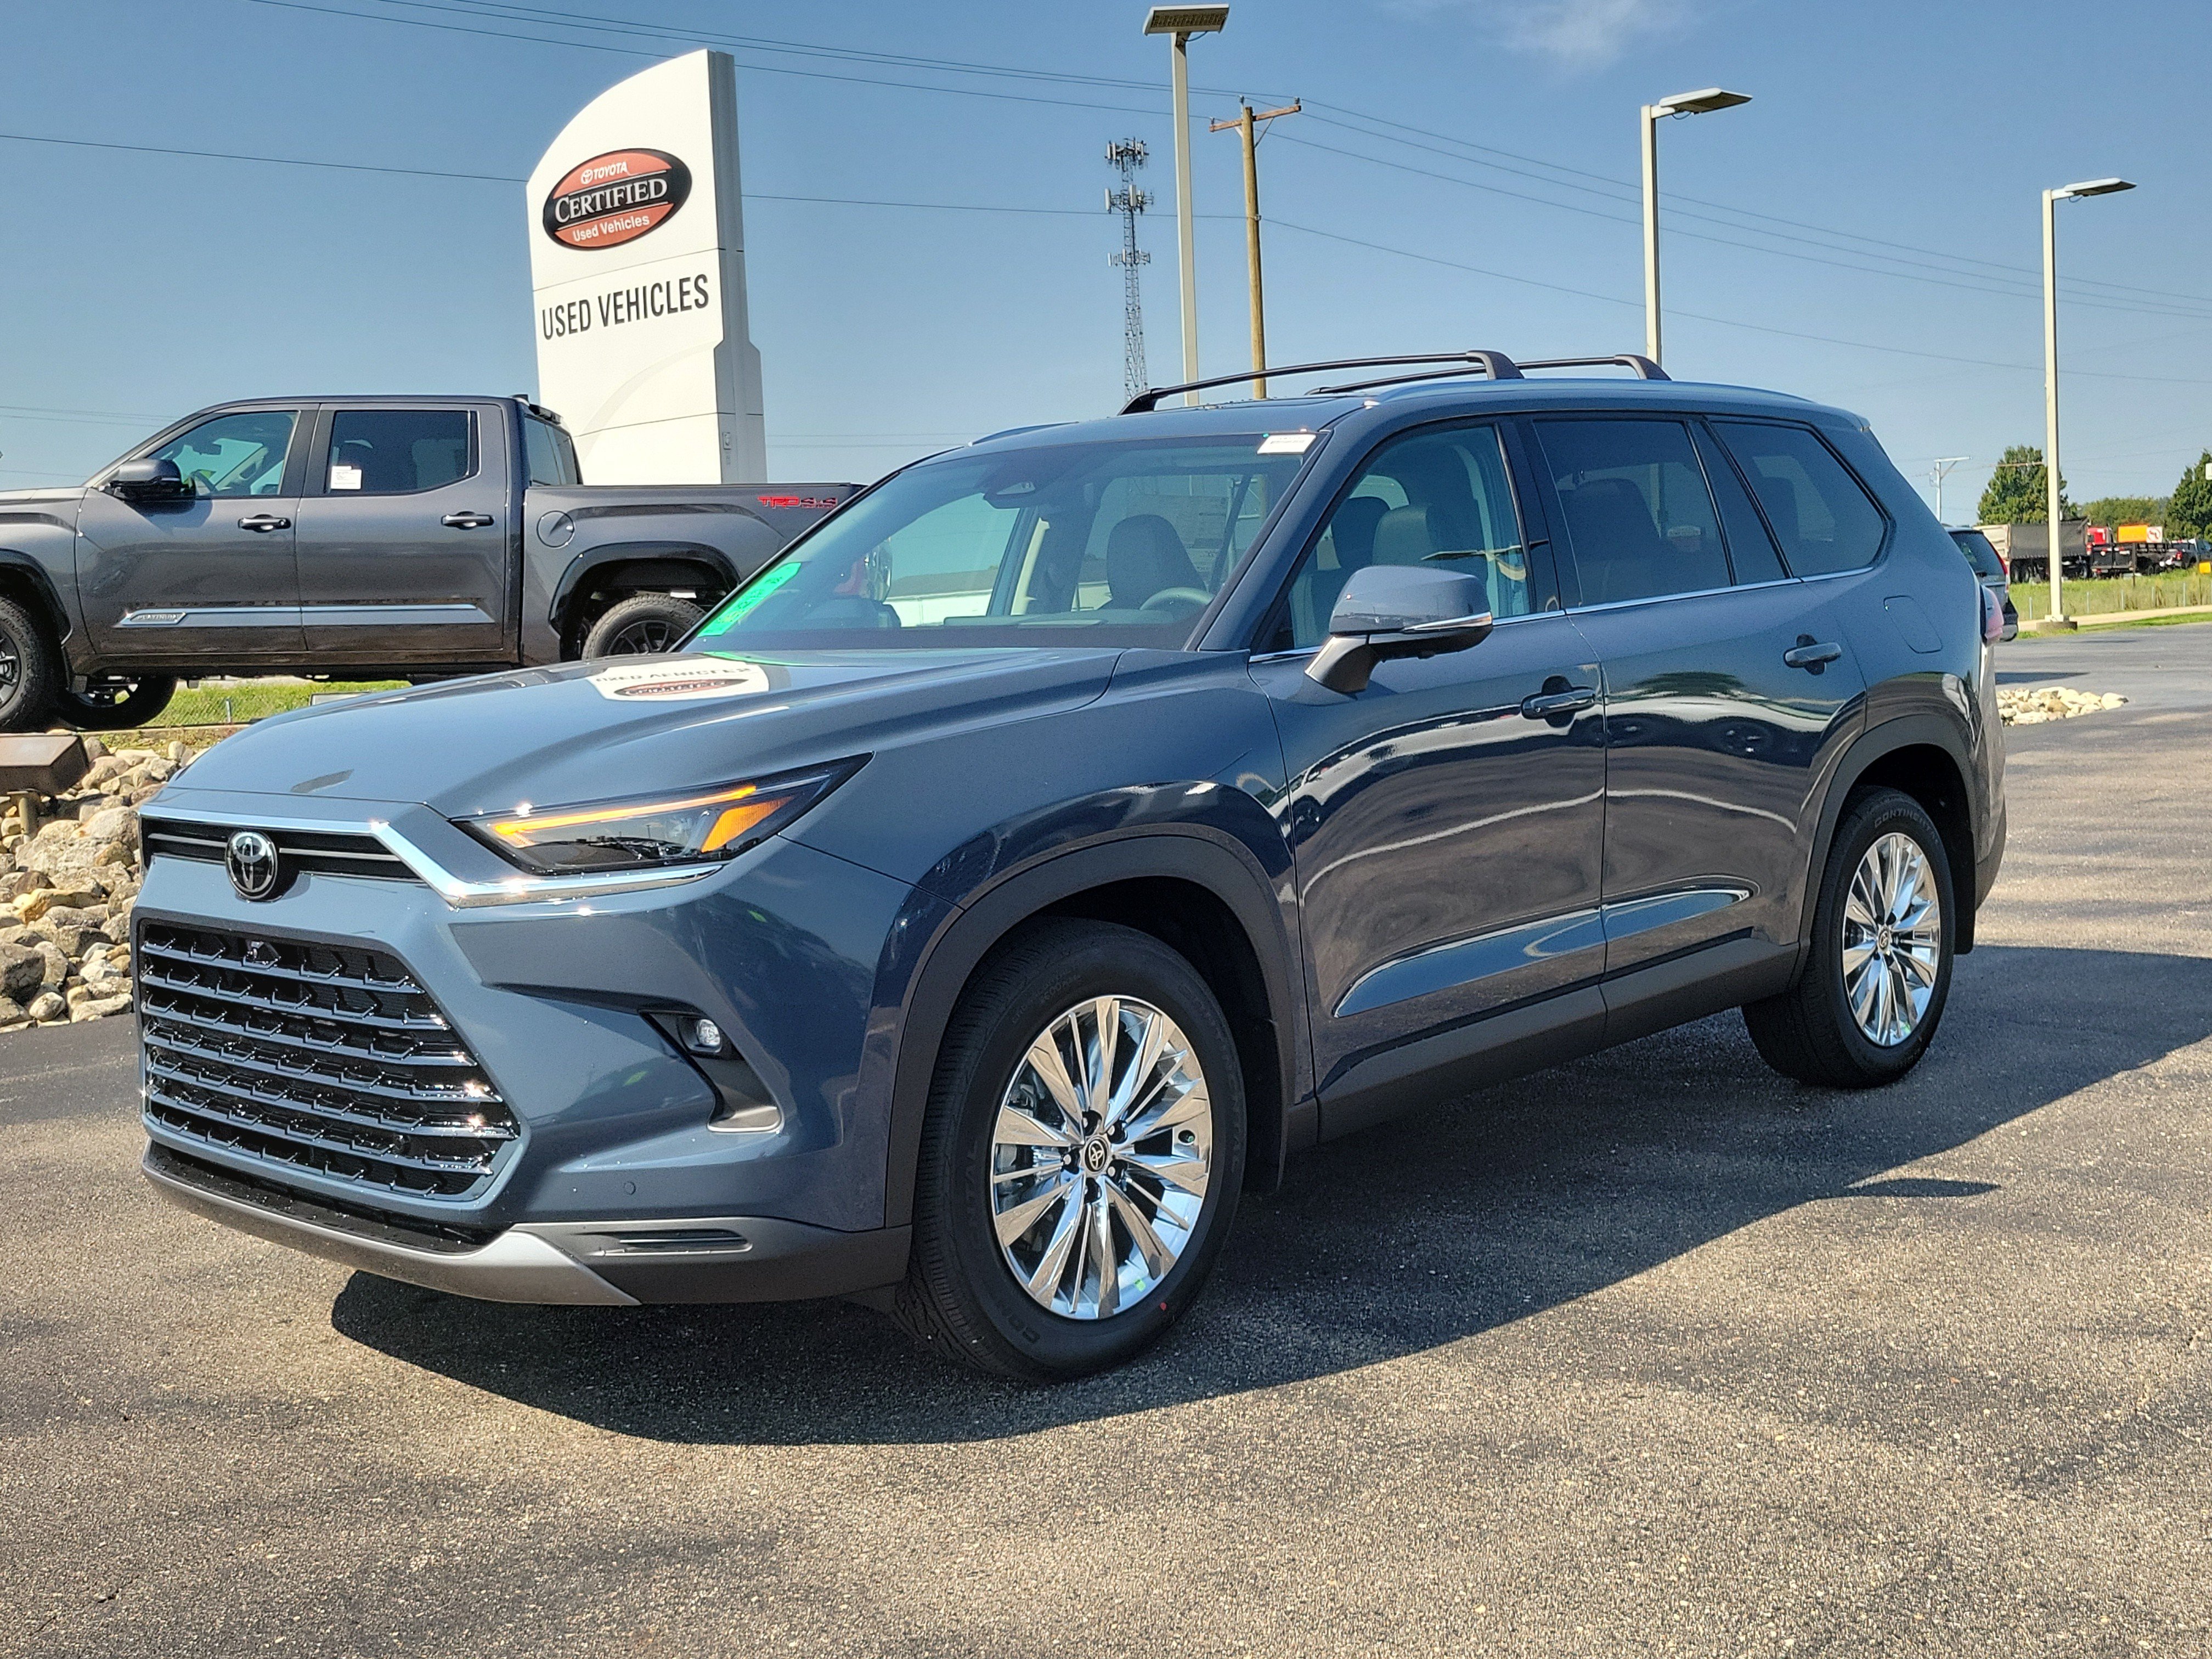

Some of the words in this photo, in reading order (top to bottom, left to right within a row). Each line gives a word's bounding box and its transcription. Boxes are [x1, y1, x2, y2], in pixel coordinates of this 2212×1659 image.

[593, 161, 628, 180] TOYOTA
[555, 178, 668, 223] CERTIFIED
[573, 226, 599, 242] Used
[600, 215, 650, 235] Vehicles
[542, 299, 591, 340] USED
[597, 274, 709, 328] VEHICLES
[758, 496, 800, 509] TRD
